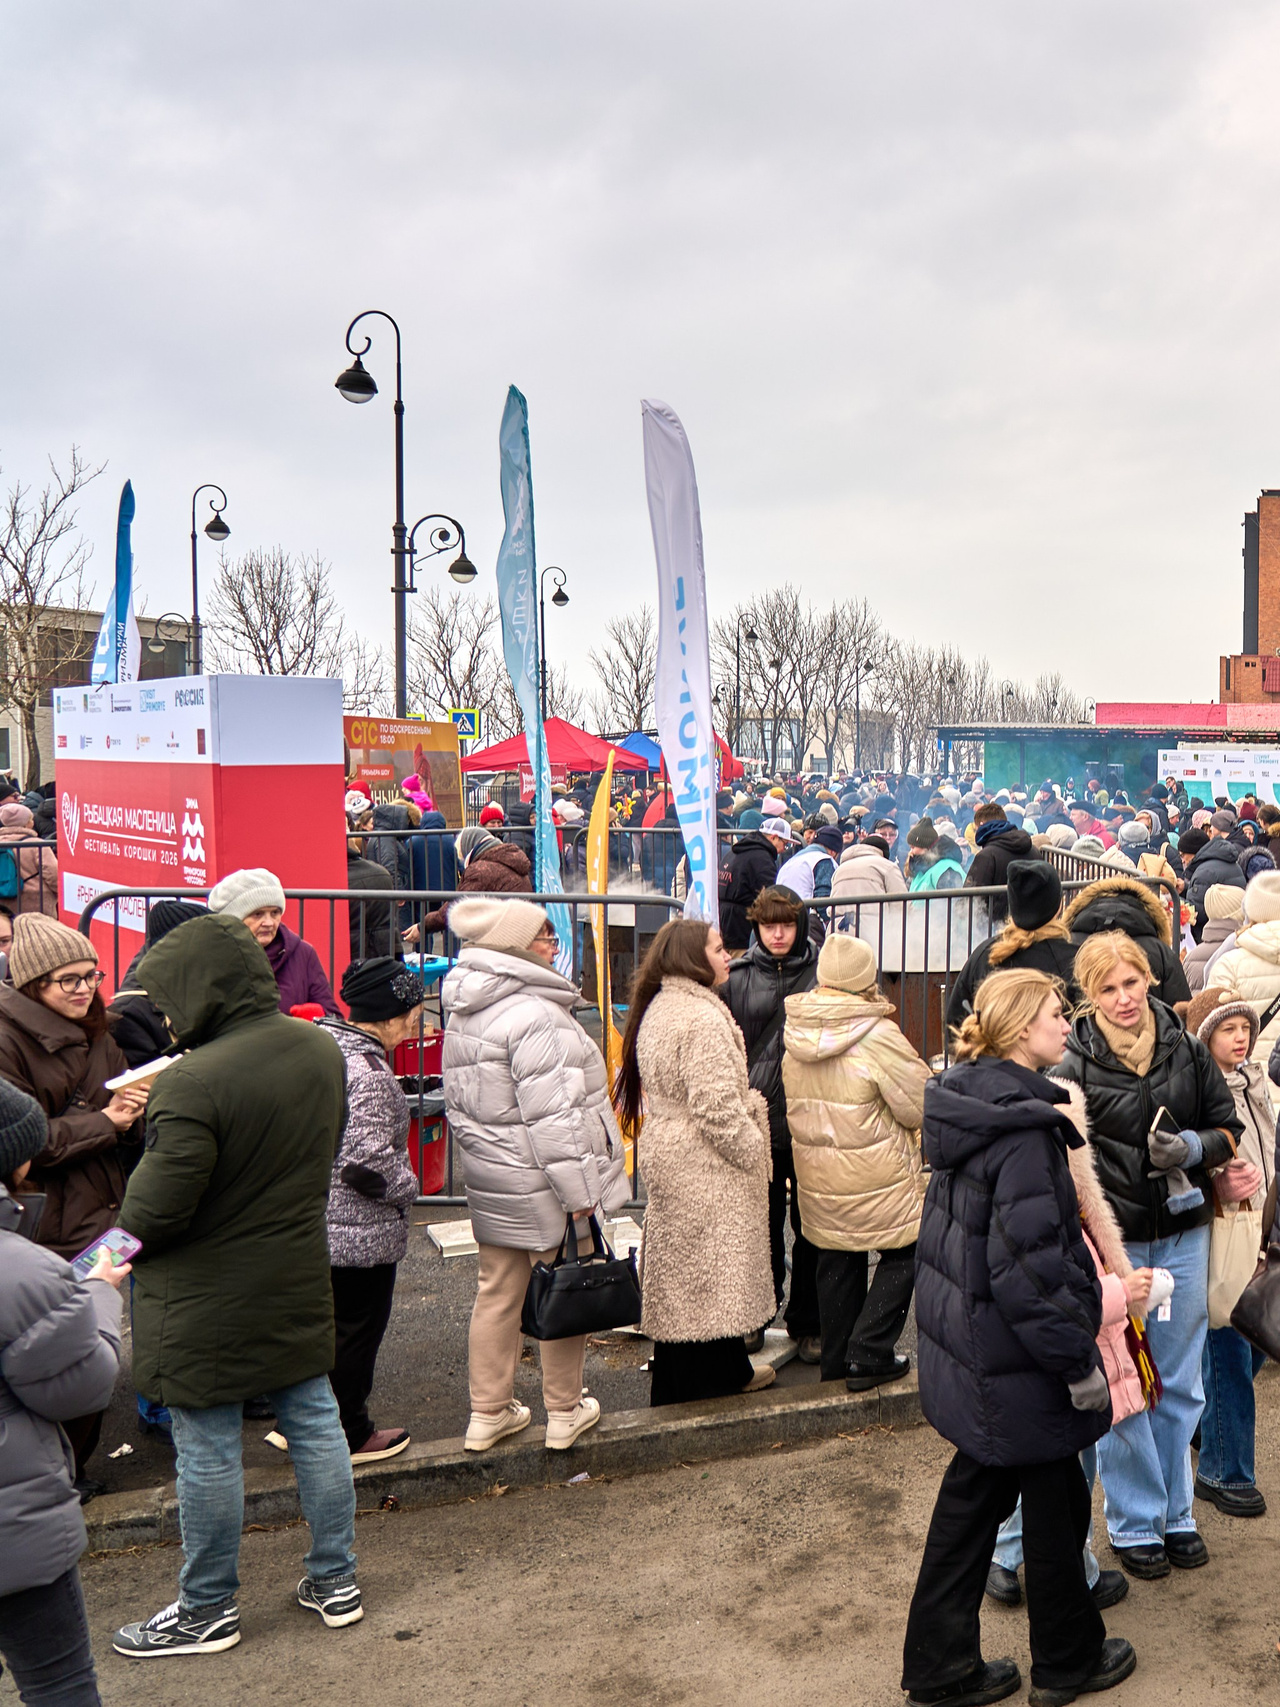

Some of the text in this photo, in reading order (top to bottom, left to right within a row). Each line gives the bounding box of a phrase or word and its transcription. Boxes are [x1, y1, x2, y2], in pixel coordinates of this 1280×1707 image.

[351, 720, 378, 745] СТС
[379, 735, 395, 745] 18:00
[380, 723, 432, 736] ПО ВОСКРЕСЕНЬЯМ
[84, 803, 177, 837] РЫБАЦКАЯ МАСЛЕНИЦА
[84, 839, 178, 866] ФЕСТИВАЛЬ КОРЮШКИ 2026
